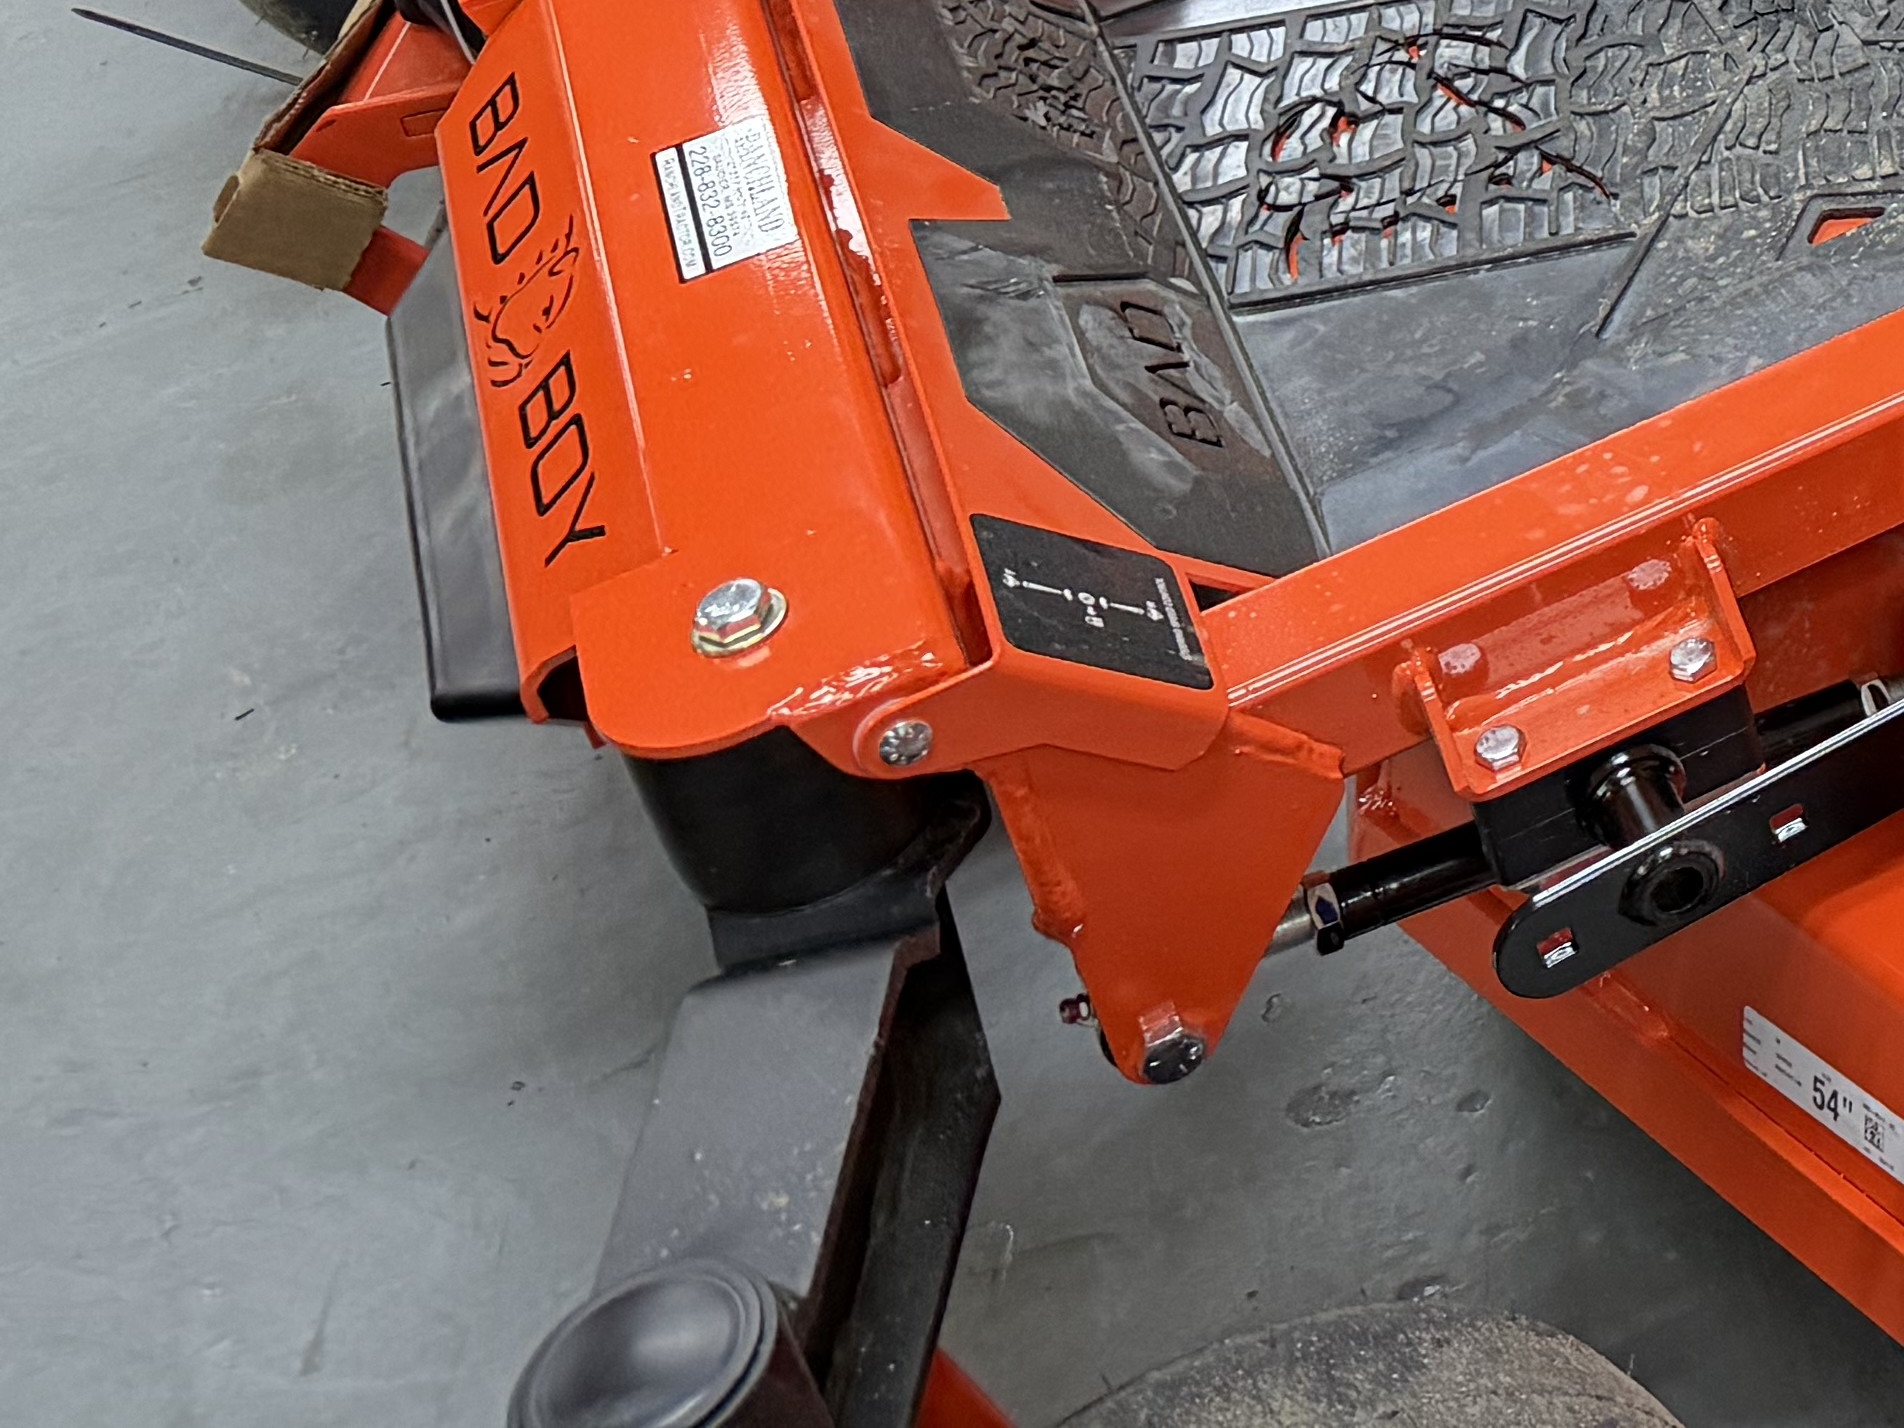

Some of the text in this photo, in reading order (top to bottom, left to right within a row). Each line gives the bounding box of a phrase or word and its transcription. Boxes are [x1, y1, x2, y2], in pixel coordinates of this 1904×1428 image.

[469, 72, 541, 266] BAD
[688, 146, 733, 257] 228-832-8300
[518, 350, 607, 567] BOY
[1119, 299, 1225, 448] BAD
